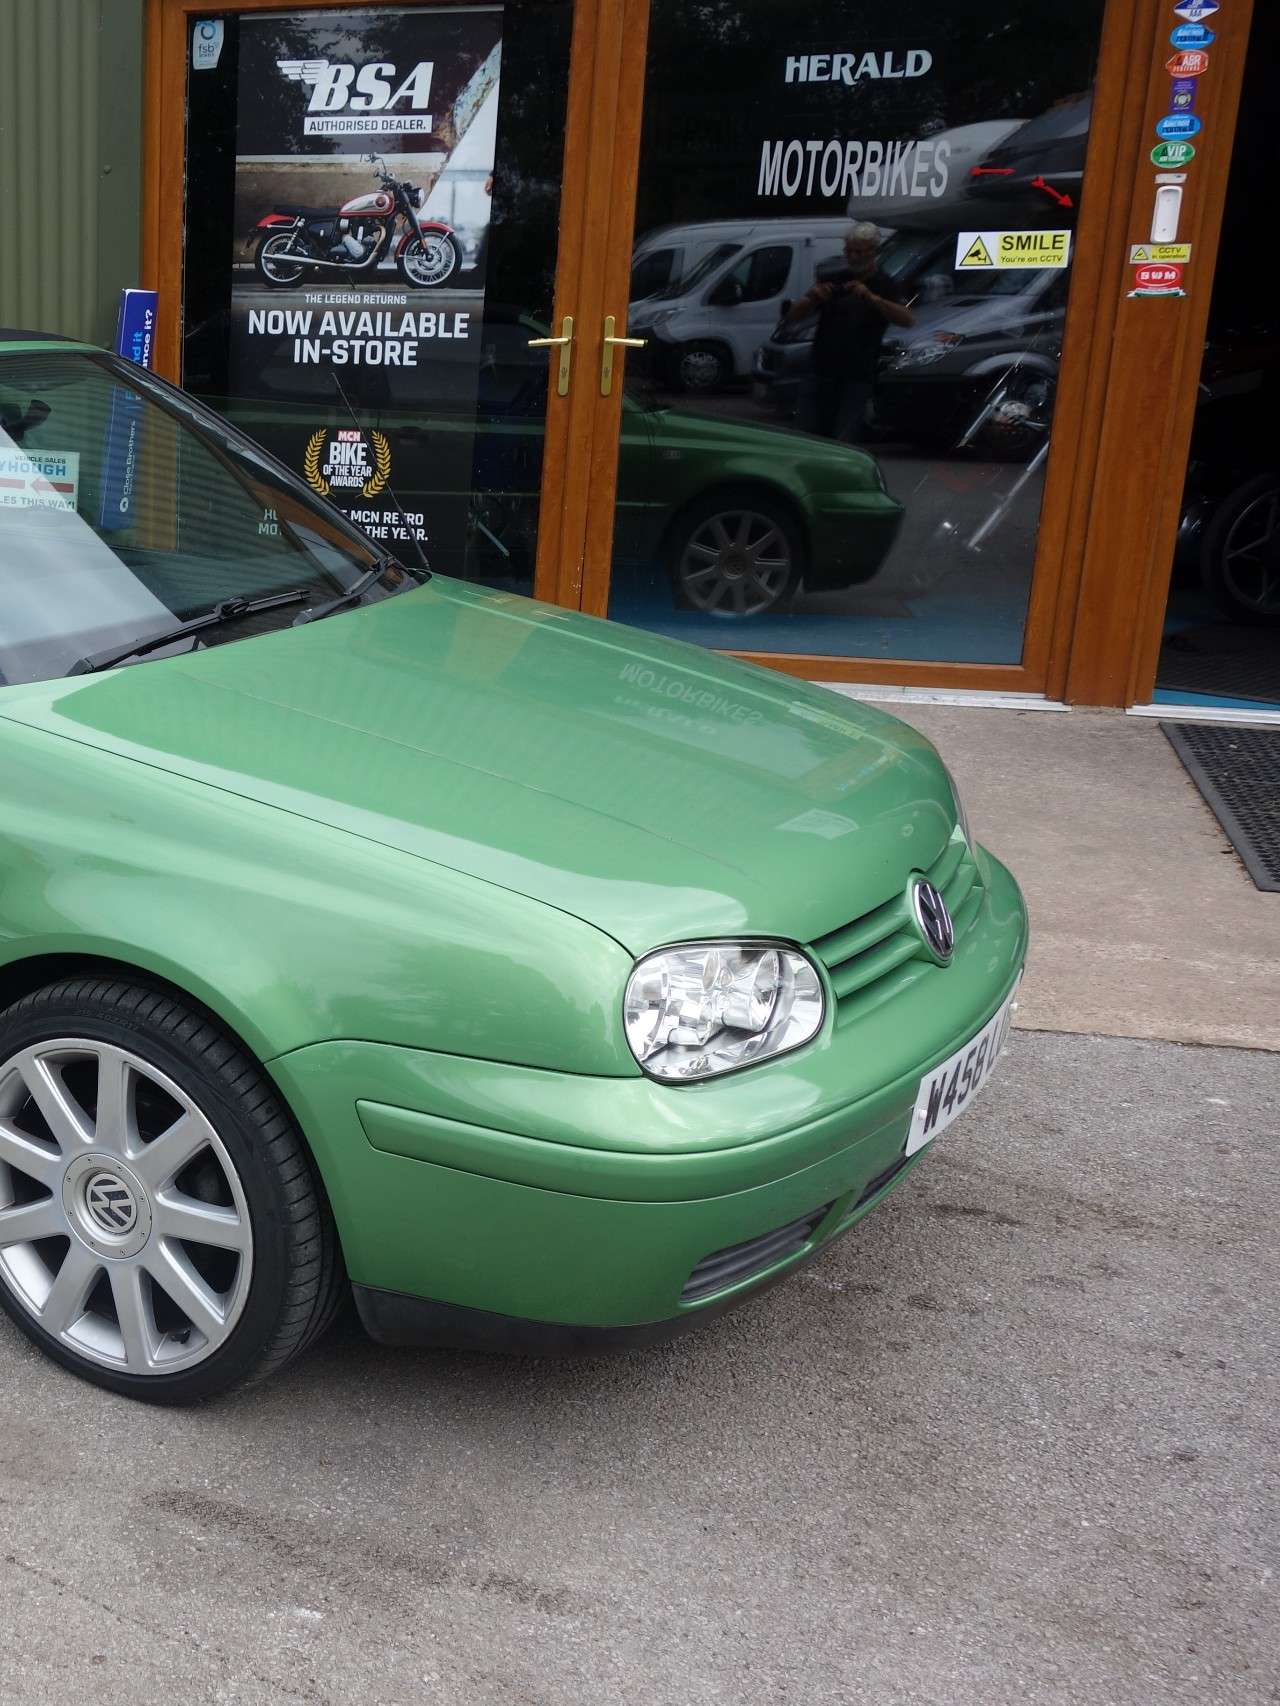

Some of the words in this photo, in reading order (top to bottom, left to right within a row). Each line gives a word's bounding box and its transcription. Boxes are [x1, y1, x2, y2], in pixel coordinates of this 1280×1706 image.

[785, 50, 933, 86] HERALD
[307, 61, 434, 112] BSA
[309, 120, 378, 132] AUTHORISED
[381, 119, 426, 131] DEALER.
[757, 139, 951, 198] MOTORBIKES
[1001, 234, 1065, 251] SMILE
[1158, 246, 1182, 254] CCTV
[1001, 255, 1026, 264] You're
[1040, 255, 1064, 263] CCTV
[305, 293, 321, 303] THE
[325, 294, 360, 304] LEGEND
[363, 295, 407, 305] RETURNS
[248, 309, 313, 335] NOW
[319, 311, 471, 339] AVAILABLE
[294, 338, 418, 366] IN-STORE
[338, 430, 361, 442] MCN
[15, 455, 41, 463] VEHICLE
[44, 457, 66, 465] SALES
[329, 442, 368, 466] BIKE
[323, 465, 334, 476] OF
[335, 465, 350, 477] THE
[351, 466, 372, 477] YEAR
[330, 476, 364, 488] AWARDS
[21, 497, 45, 507] THIS
[350, 510, 380, 523] MCN
[365, 526, 388, 539] THE
